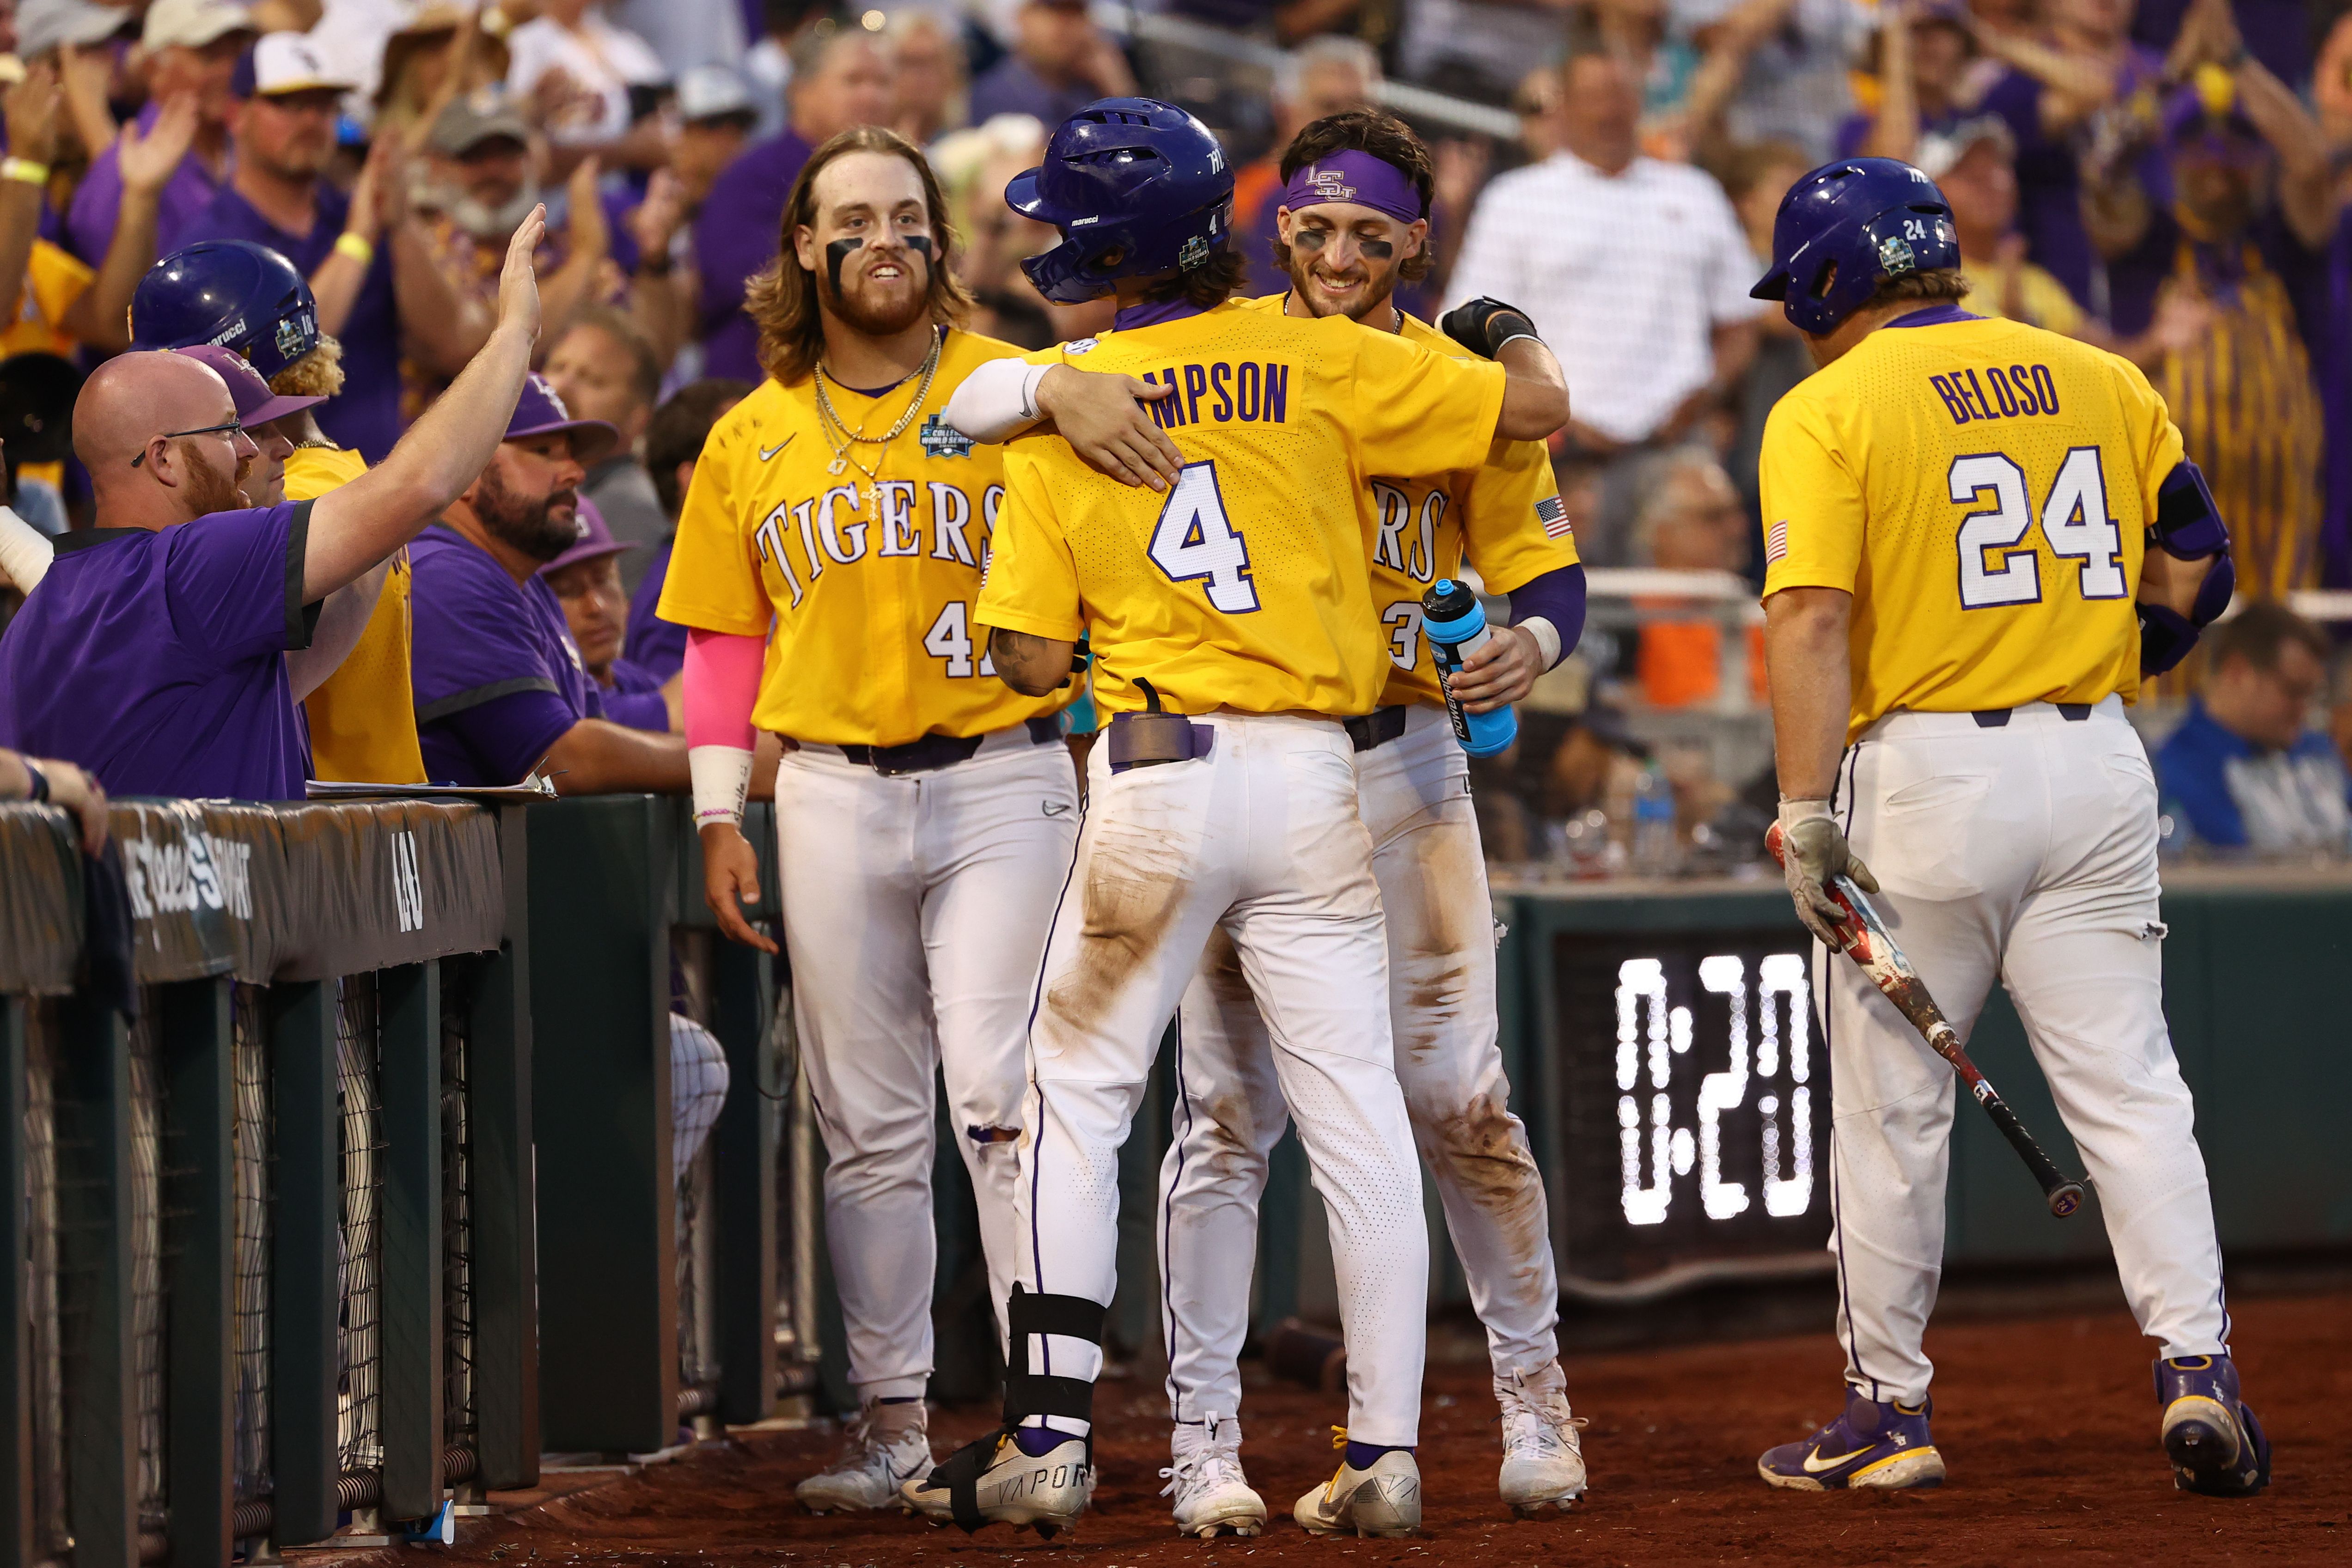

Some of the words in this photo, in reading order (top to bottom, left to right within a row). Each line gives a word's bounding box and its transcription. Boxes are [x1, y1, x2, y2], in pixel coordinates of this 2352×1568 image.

[1304, 158, 1357, 202] LSU
[1071, 215, 1099, 227] marucci
[1209, 214, 1217, 235] 4
[1902, 220, 1927, 241] 24
[1135, 362, 1289, 430] MPSON
[1929, 364, 2060, 425] BELOSO
[1147, 459, 1262, 614] 4
[1947, 445, 2129, 610] 24
[922, 600, 1001, 678] 4
[1437, 667, 1466, 738] POWERADE
[1615, 954, 1814, 1225] 0:20
[998, 1464, 1087, 1505] VAPOR
